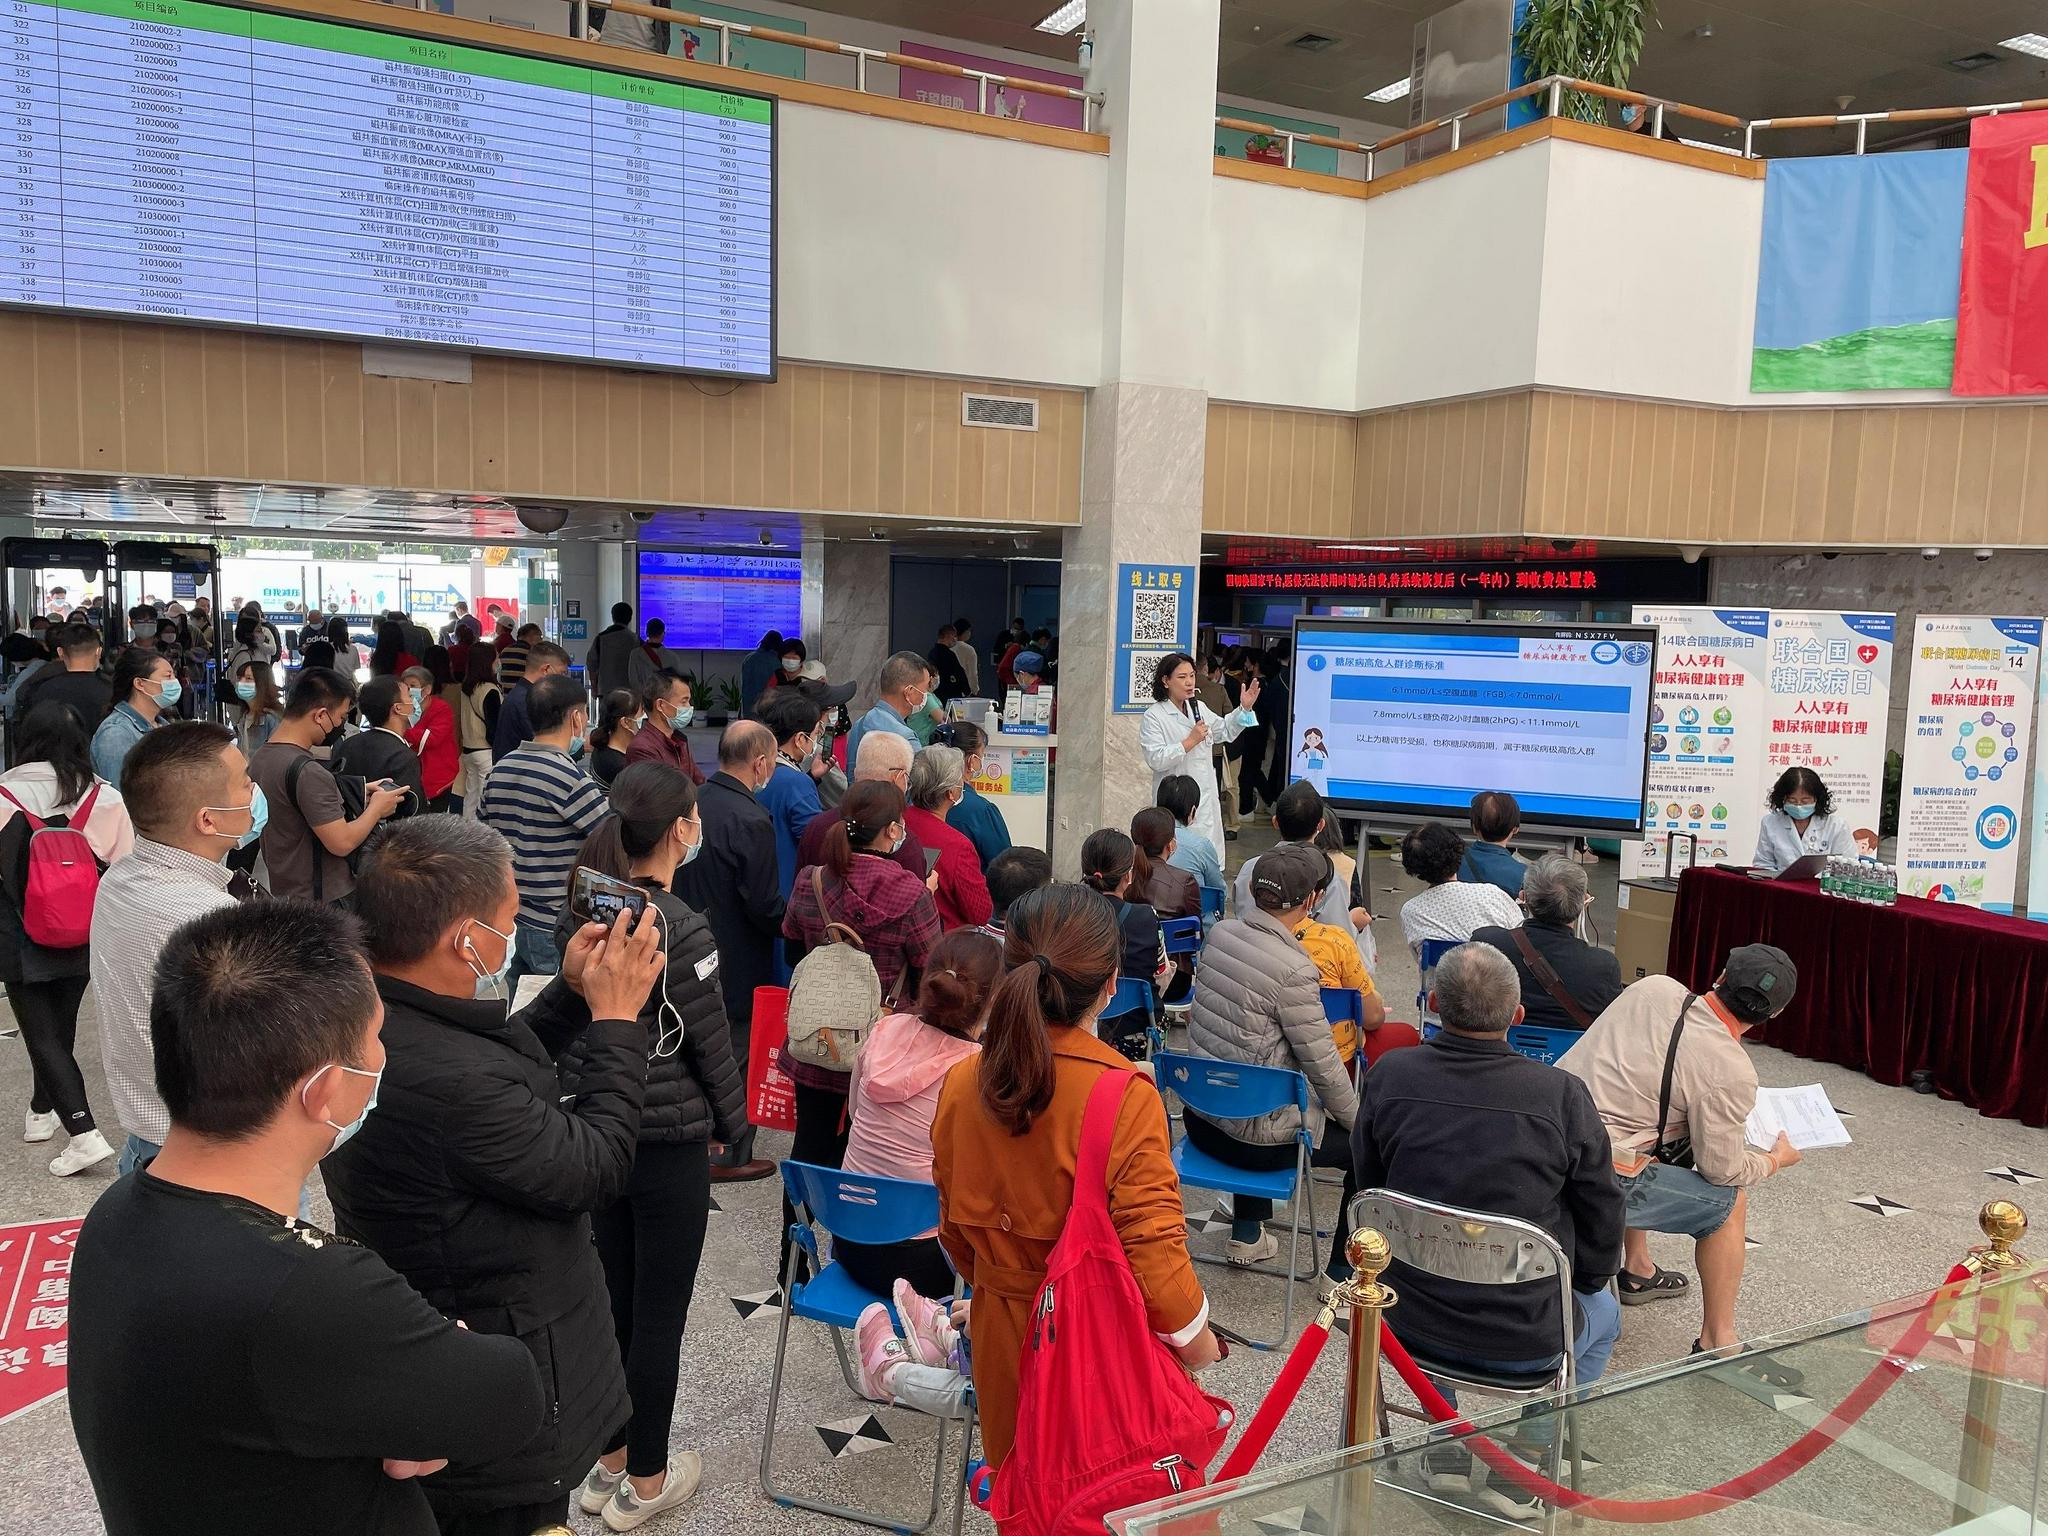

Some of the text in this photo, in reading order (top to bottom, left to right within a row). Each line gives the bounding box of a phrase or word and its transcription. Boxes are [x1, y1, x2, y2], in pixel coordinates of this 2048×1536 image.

[13, 3, 28, 13] 321
[14, 19, 29, 29] 322
[129, 22, 182, 37] 210200002-2
[14, 36, 29, 46] 323
[129, 38, 182, 53] 210200002-3
[14, 52, 30, 62] 324
[134, 54, 178, 68] 210200003
[15, 68, 31, 78] 325
[134, 70, 179, 84] 210200004
[15, 84, 31, 95] 326
[131, 85, 183, 99] 210200005-1
[16, 100, 32, 110] 327
[131, 100, 183, 115] 210200005-2
[16, 117, 32, 127] 328
[135, 116, 180, 130] 210200006
[16, 133, 32, 143] 329
[135, 132, 180, 146] 210200007
[17, 149, 33, 159] 330
[136, 148, 180, 161] 210200008
[17, 165, 33, 175] 331
[132, 163, 184, 177] 210300000-1
[18, 181, 34, 191] 332
[132, 179, 185, 193] 210300000-2
[19, 197, 34, 207] 333
[133, 194, 185, 208] 210300000-3
[19, 213, 34, 223] 334
[137, 210, 181, 224] 210300001
[19, 229, 35, 238] 335
[134, 226, 186, 239] 210300001-1
[19, 245, 35, 255] 336
[138, 242, 182, 254] 210300002
[20, 261, 36, 270] 337
[138, 257, 183, 270] 210300004
[20, 277, 36, 286] 338
[20, 293, 37, 302] 339
[1131, 571, 1182, 588] 线上取号
[1774, 637, 1851, 665] 联合国
[1335, 657, 1444, 670] 糖尿病高危人群诊断标准
[1672, 654, 1725, 667] 人人享有
[2008, 656, 2023, 668] 14
[1771, 668, 1872, 695] 糖尿病日
[1950, 678, 1998, 691] 人人享有
[1931, 693, 2015, 707] 糖尿病健康管理
[1794, 701, 1848, 715] 人人享有
[1918, 715, 1943, 725] 糖尿病
[1772, 719, 1868, 735] 糖尿病健康管理
[1917, 727, 1942, 737] 的危害
[1769, 742, 1813, 754] 健康生活
[1913, 787, 1977, 796] 糖尿病的综合治疗
[1907, 860, 1986, 869] 糖尿病健康管理五要素
[1258, 878, 1282, 890] NAUTICA
